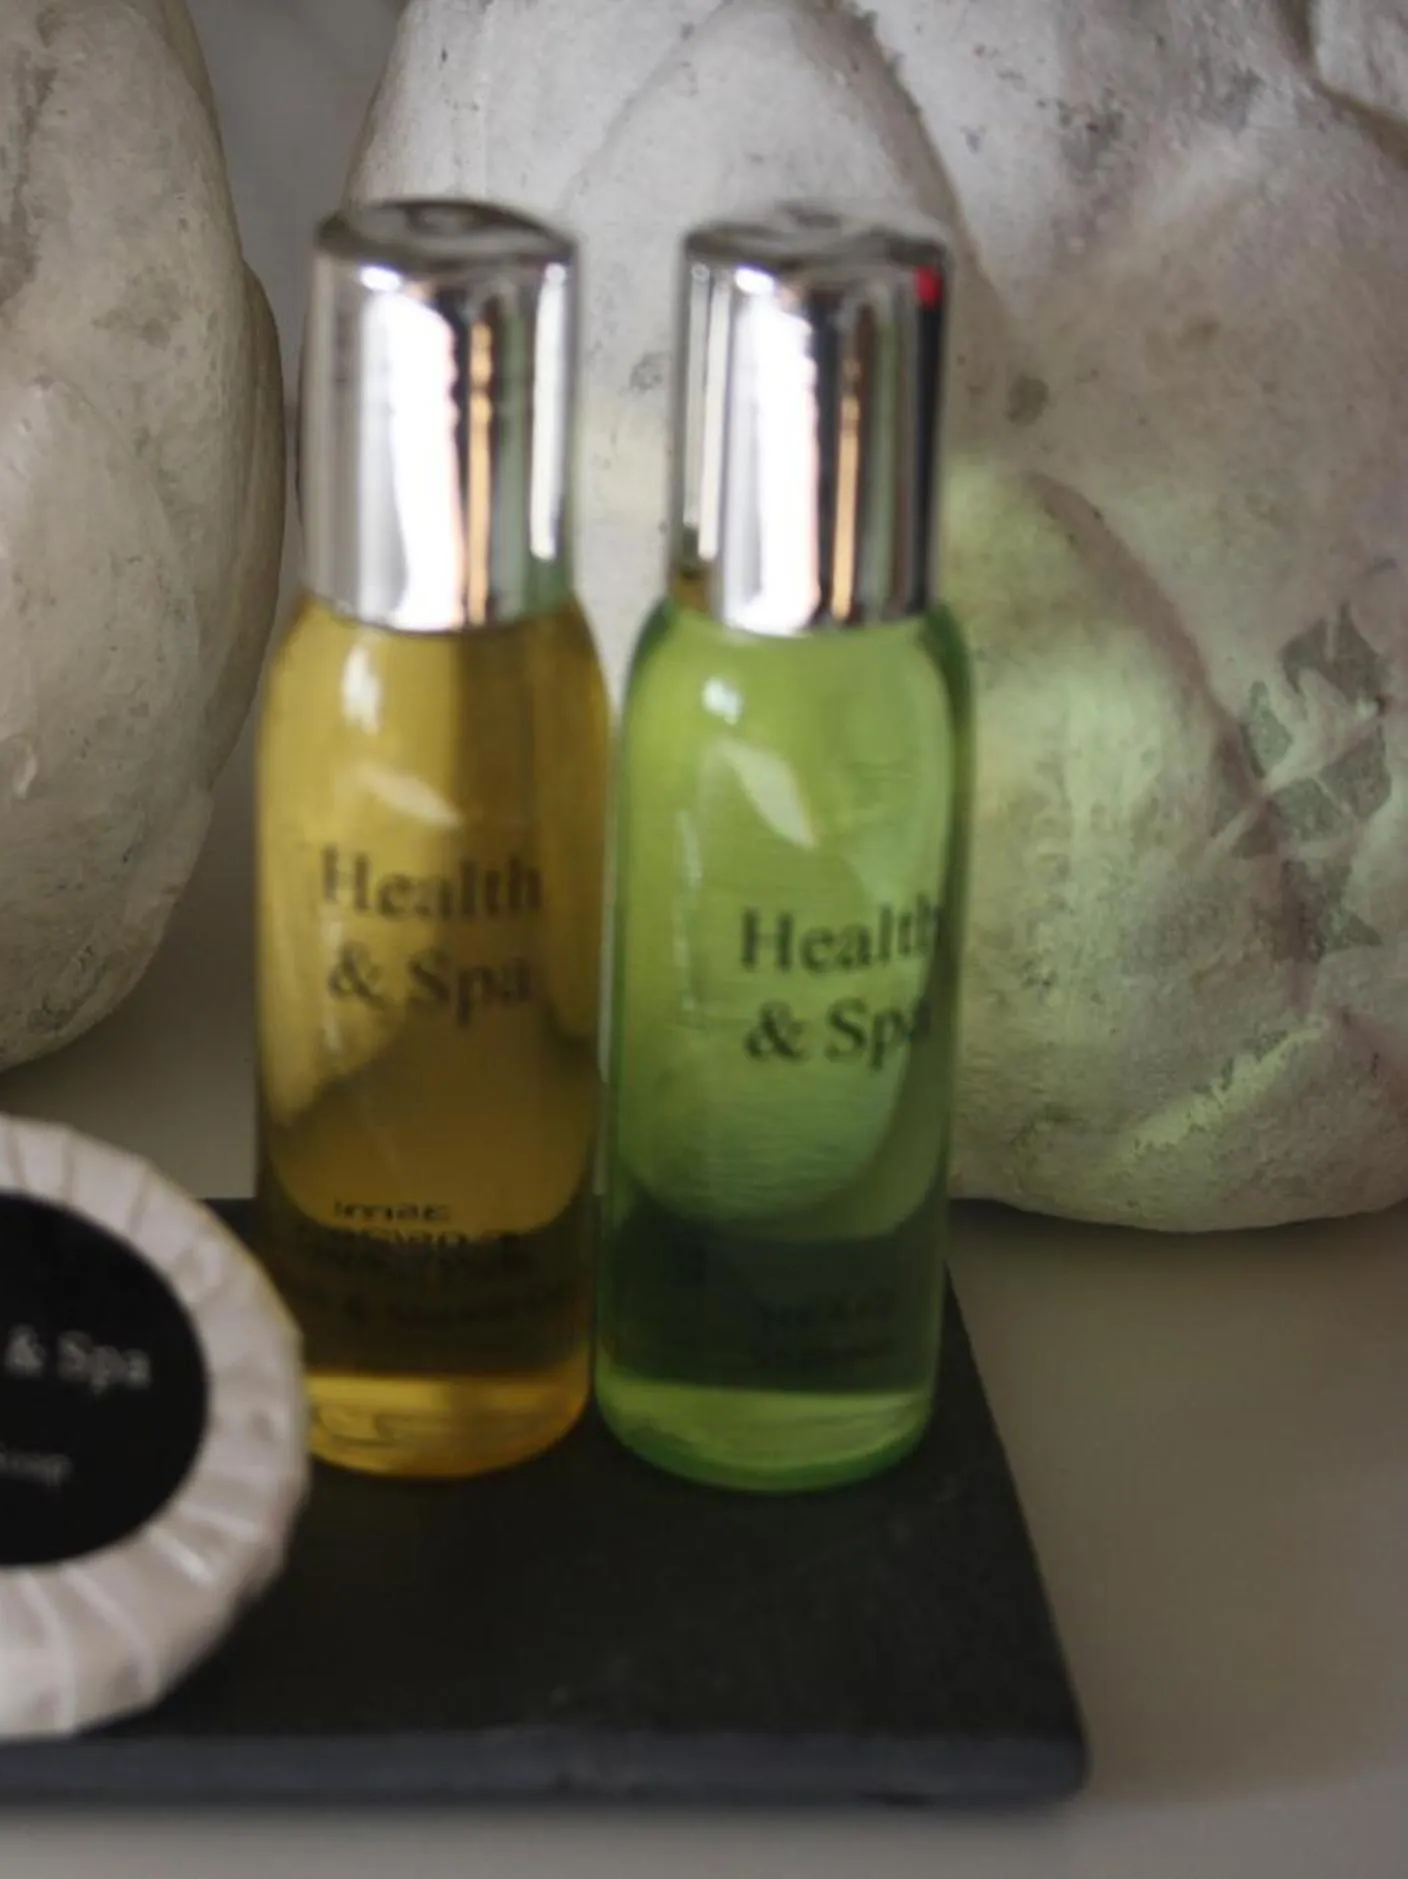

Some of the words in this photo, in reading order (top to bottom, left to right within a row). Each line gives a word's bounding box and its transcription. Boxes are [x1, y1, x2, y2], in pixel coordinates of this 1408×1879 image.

[321, 844, 542, 921] Health
[328, 940, 386, 1007] &
[407, 947, 534, 1026] Spa
[745, 1000, 808, 1062] &
[5, 1324, 46, 1376] &
[58, 1330, 152, 1393] Spa
